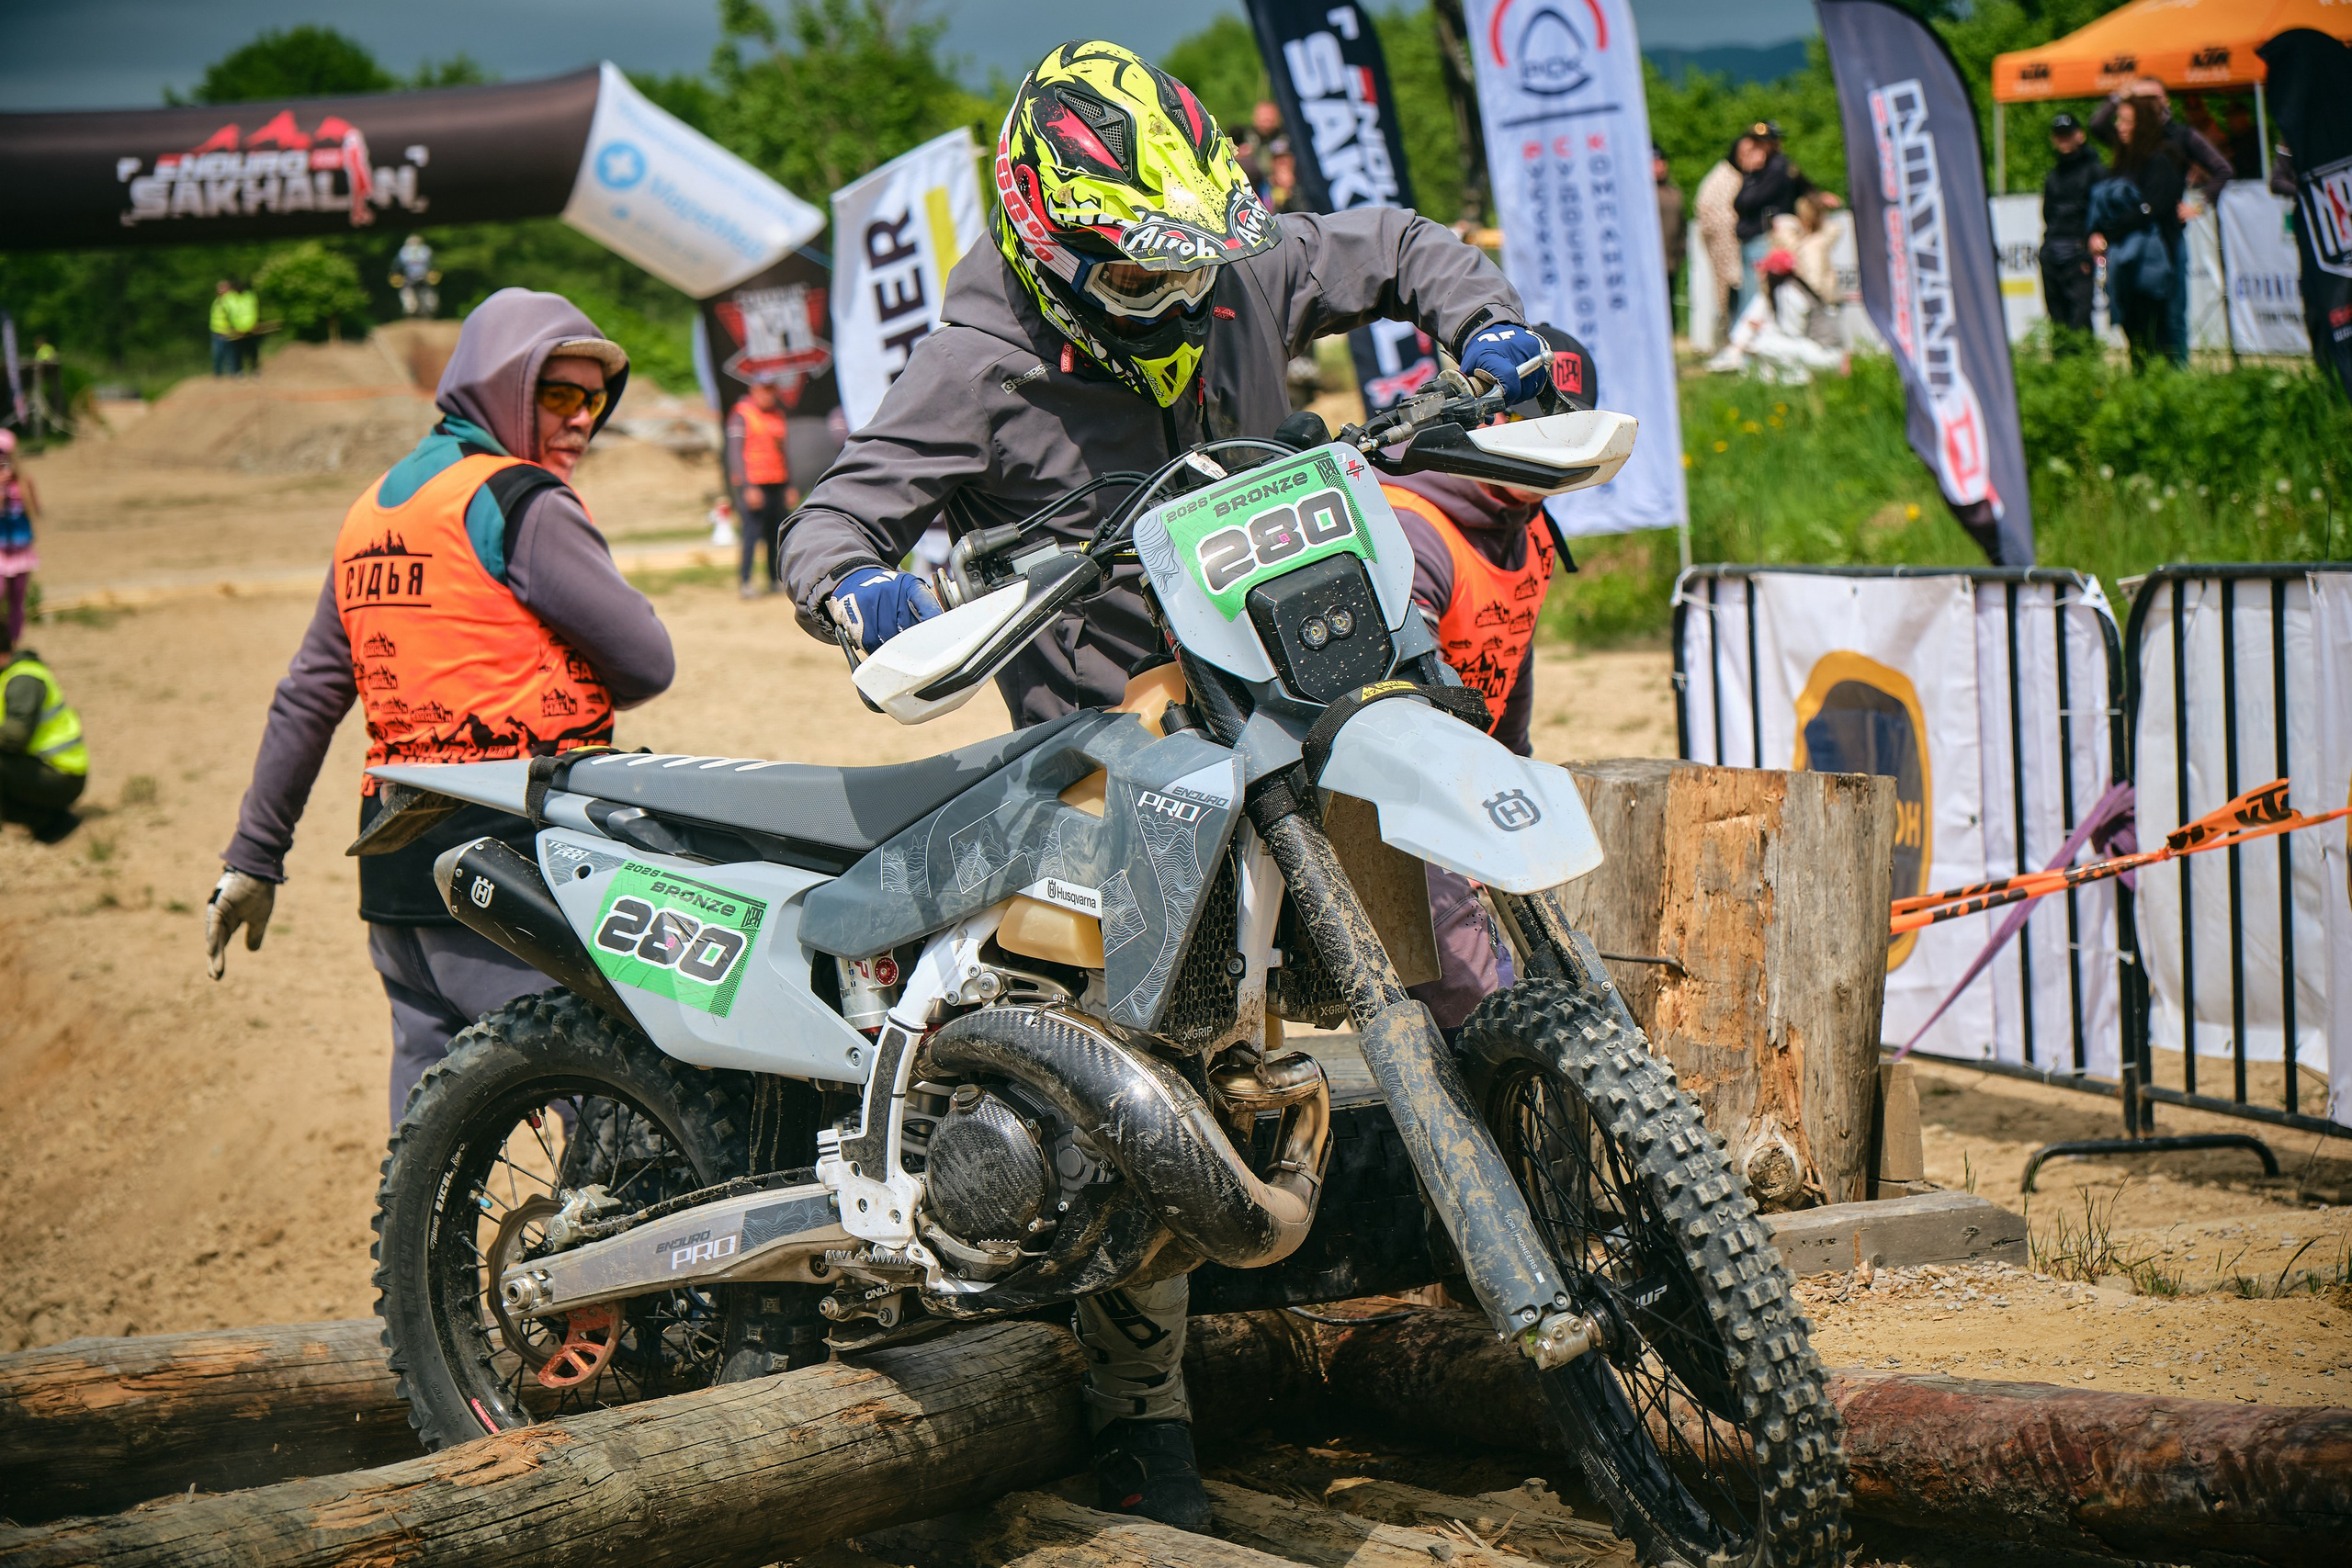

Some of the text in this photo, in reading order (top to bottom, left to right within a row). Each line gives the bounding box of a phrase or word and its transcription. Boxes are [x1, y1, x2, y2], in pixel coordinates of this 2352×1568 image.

[1126, 224, 1216, 258] Airoh
[1197, 488, 1355, 594] 280
[345, 562, 424, 601] СУДЬЯ
[1136, 790, 1201, 823] PRO
[1172, 785, 1229, 807] ENDURO
[1057, 886, 1096, 908] Husqvarna
[596, 897, 745, 983] 280
[1182, 1026, 1214, 1040] X-GRIP
[434, 1170, 455, 1213] EXCEL
[449, 1143, 466, 1168] Rim
[655, 1230, 711, 1254] ENDURO
[672, 1235, 737, 1270] PRO
[1504, 1213, 1538, 1270] FOR PIONEERS
[865, 1284, 891, 1300] ONLY
[1623, 1483, 1651, 1521] EXCEL
